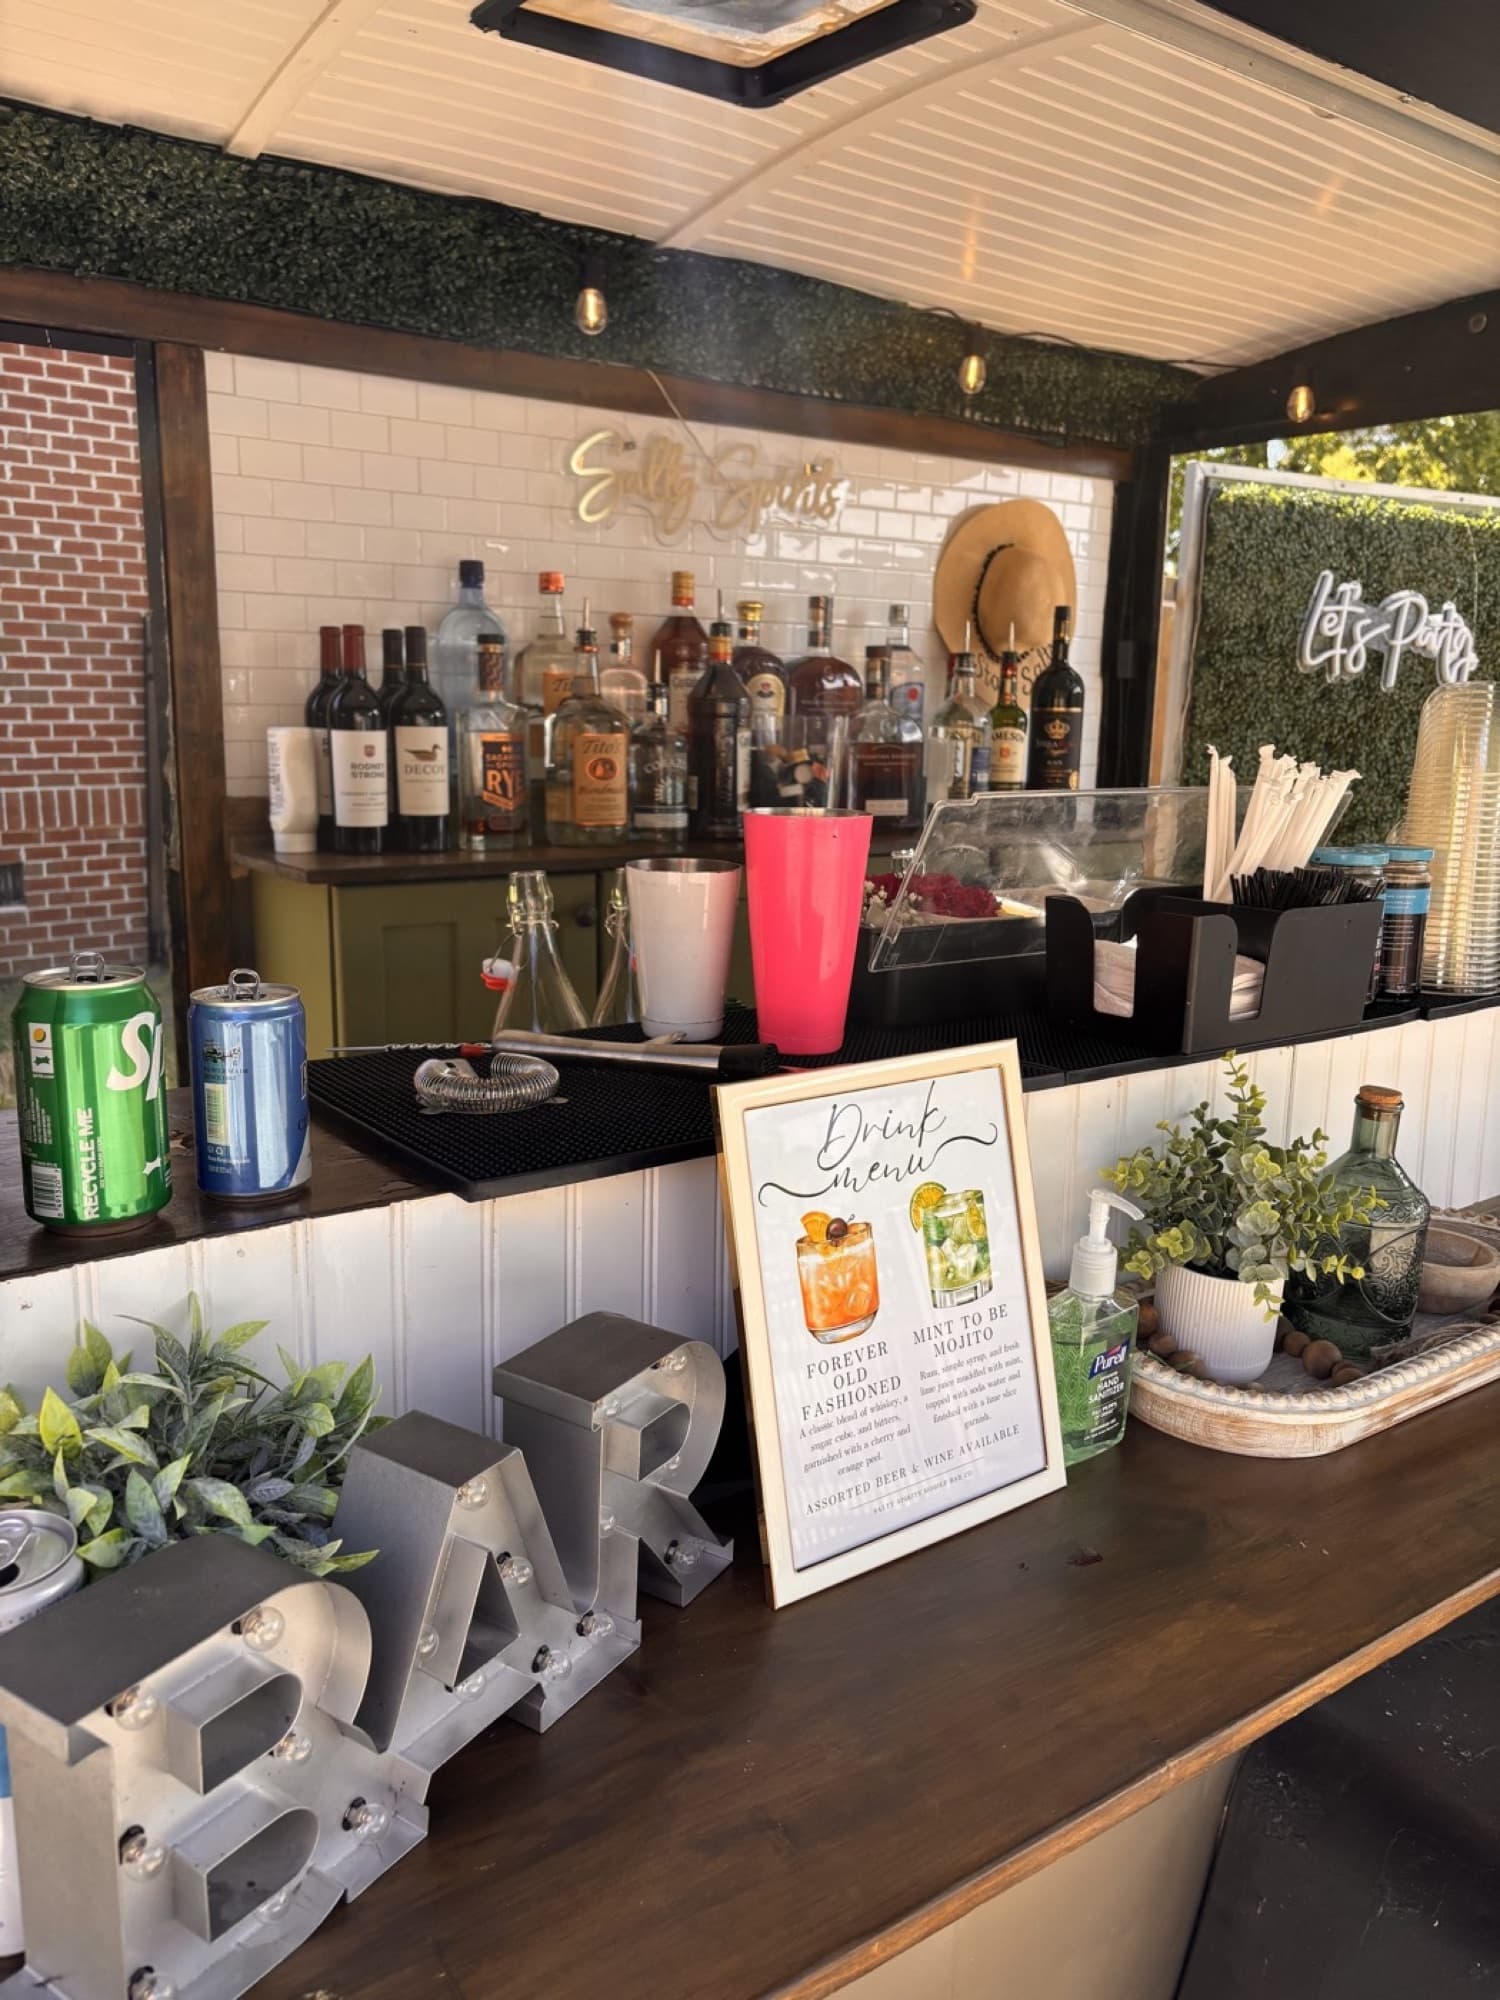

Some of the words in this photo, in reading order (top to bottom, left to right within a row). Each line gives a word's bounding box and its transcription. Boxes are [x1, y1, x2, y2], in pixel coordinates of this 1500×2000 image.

[1380, 589, 1479, 692] Party
[75, 1107, 94, 1136] ME
[816, 1079, 947, 1171] Drink
[78, 1138, 100, 1219] RECYCLE
[912, 1319, 954, 1345] MINT
[960, 1311, 983, 1330] TO
[988, 1303, 1008, 1321] BE
[933, 1326, 994, 1358] MOJITO
[942, 1360, 964, 1373] simple
[989, 1346, 1002, 1358] and
[1093, 1344, 1128, 1374] Purell
[806, 1340, 889, 1380] FOREVER
[832, 1366, 868, 1390] OLD
[919, 1385, 936, 1397] lime
[987, 1362, 1004, 1373] with
[925, 1392, 951, 1410] topped
[952, 1389, 968, 1401] with
[969, 1382, 986, 1395] soda
[987, 1376, 1007, 1388] water
[1007, 1369, 1021, 1381] and
[801, 1375, 902, 1421] FASHIONED
[932, 1405, 961, 1423] finished
[962, 1401, 979, 1413] with
[986, 1393, 1002, 1405] lime
[799, 1428, 807, 1440] A
[808, 1420, 834, 1436] classic
[836, 1410, 858, 1425] blend
[810, 1438, 833, 1452] sugar
[834, 1430, 856, 1443] cube,
[857, 1421, 873, 1435] and
[803, 1449, 842, 1473] garnished
[843, 1443, 862, 1457] with
[870, 1431, 895, 1447] cherry
[896, 1423, 911, 1437] and
[805, 1481, 872, 1516] ASSORTED
[875, 1466, 908, 1490] BEER
[911, 1463, 920, 1474] &
[923, 1448, 955, 1469] WINE
[959, 1423, 1021, 1457] AVAILABLE
[837, 1461, 864, 1476] orange
